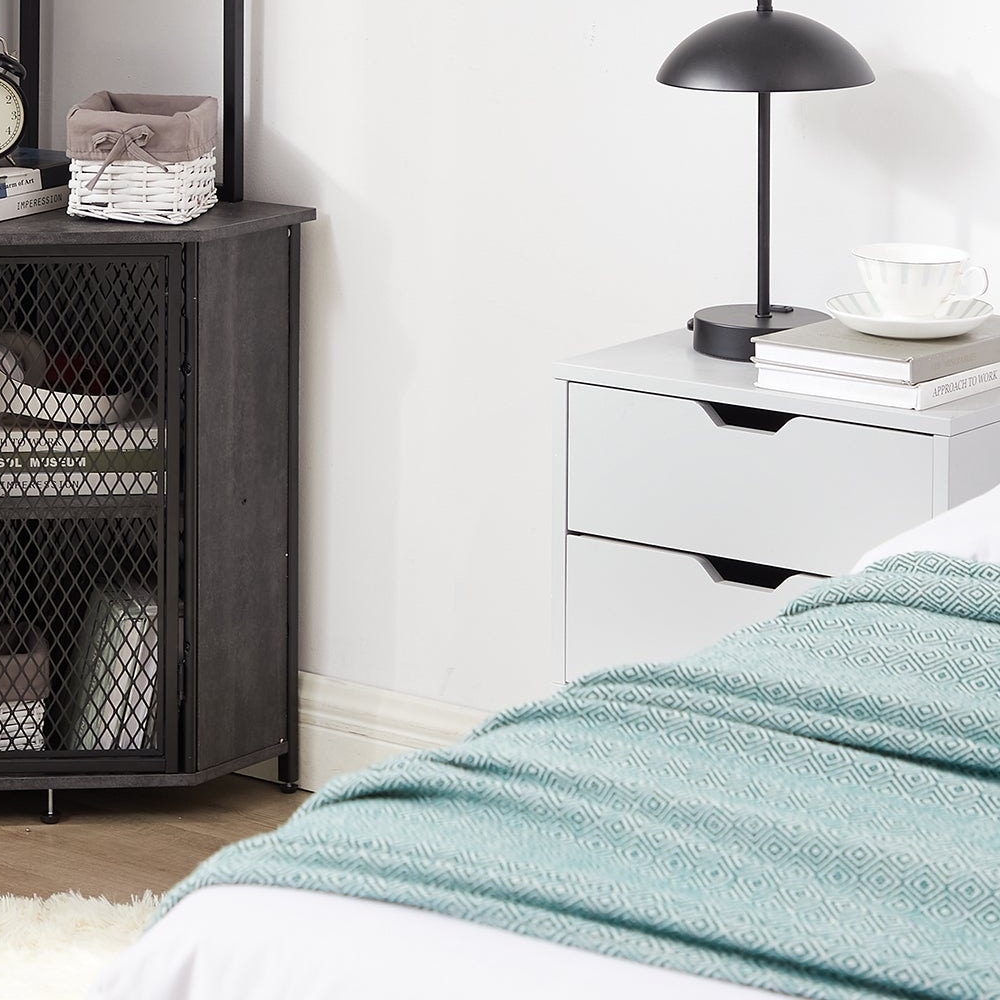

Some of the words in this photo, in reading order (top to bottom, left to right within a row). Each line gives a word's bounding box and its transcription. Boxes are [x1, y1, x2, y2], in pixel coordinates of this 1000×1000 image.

[6, 96, 12, 104] 2
[11, 111, 17, 120] 3
[5, 127, 12, 135] 4
[17, 179, 24, 187] of
[17, 193, 63, 211] IMPERESSION
[932, 379, 967, 397] APPROACH
[968, 376, 977, 387] TO
[978, 370, 998, 383] WORK
[29, 457, 86, 468] MUSEUM
